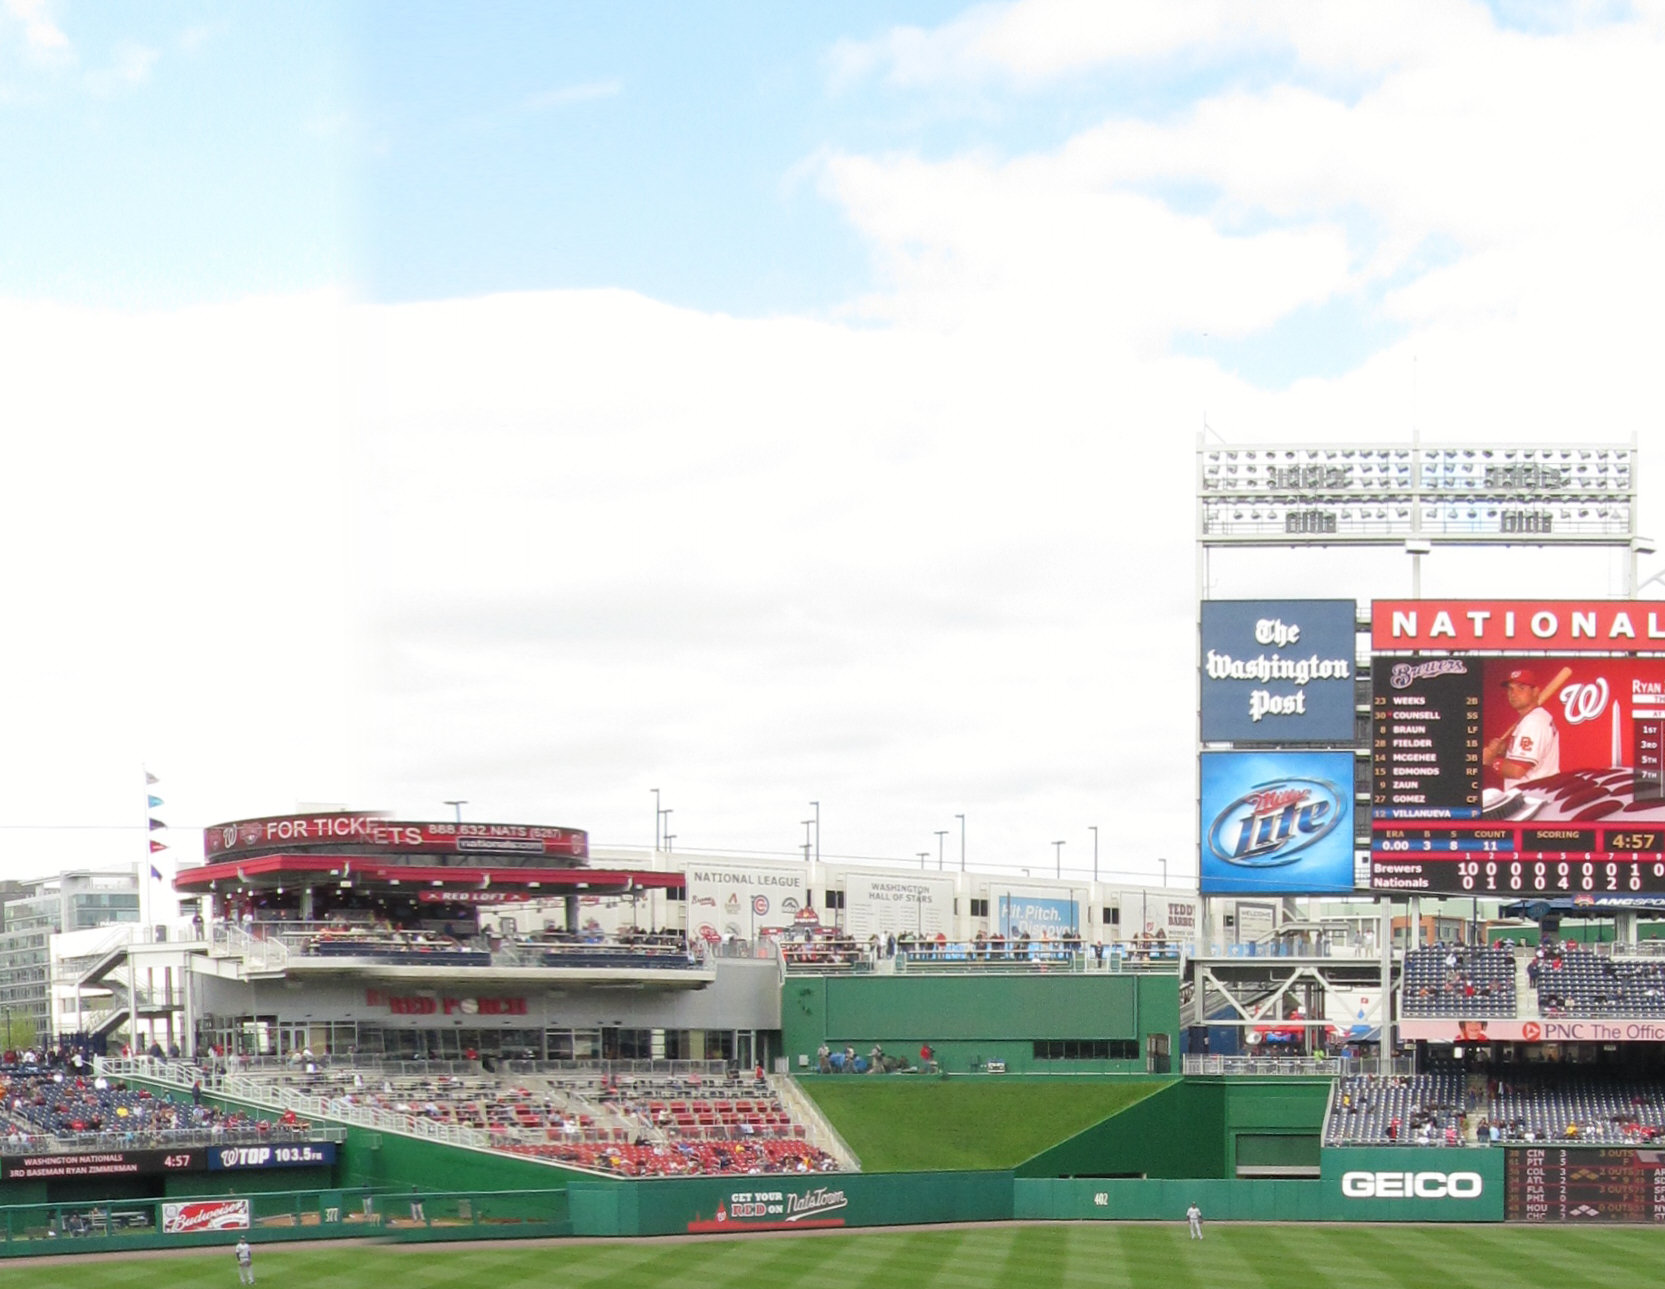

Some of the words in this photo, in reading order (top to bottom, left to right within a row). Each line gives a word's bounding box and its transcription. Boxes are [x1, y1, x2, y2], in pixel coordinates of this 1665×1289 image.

[1255, 619, 1300, 647] The
[1206, 650, 1350, 684] Washington
[1391, 660, 1468, 689] Brewers
[1632, 680, 1661, 693] RYAN
[1249, 689, 1306, 721] Post
[1393, 697, 1425, 705] WEEKS
[1393, 712, 1440, 720] COUNSELL
[1393, 726, 1425, 734] BRAUN
[1393, 739, 1432, 748] FIELDER
[1393, 754, 1436, 762] MCGEHEE
[1393, 768, 1439, 776] EDMONDS
[1393, 781, 1418, 789] ZAUN
[1393, 795, 1425, 803] GOMEZ
[1393, 810, 1451, 818] VILLANUEVA
[267, 820, 308, 840] FOR
[1233, 800, 1330, 858] Lite
[1537, 831, 1579, 839] SCORING
[1382, 841, 1409, 851] 0.00
[1612, 834, 1655, 849] 4:57
[1374, 863, 1422, 873] Brewers
[694, 872, 753, 885] NATIONAL
[758, 875, 800, 888] LEAGUE
[1374, 878, 1428, 888] Nationals
[872, 883, 930, 894] WASHINGTON
[443, 892, 470, 901] RED
[473, 892, 507, 901] LOFT
[869, 892, 891, 901] HALL
[894, 893, 905, 901] OF
[906, 894, 933, 903] STARS
[1026, 906, 1061, 922] Pitch.
[1545, 1024, 1584, 1039] PNC
[1590, 1024, 1621, 1039] The
[24, 1156, 76, 1166] WASHINGTON
[79, 1154, 123, 1165] NATIONALS
[164, 1155, 190, 1168] 4:57
[9, 1168, 24, 1177] 3RD
[26, 1167, 64, 1177] BASEMAN
[66, 1166, 87, 1176] RYAN
[89, 1164, 137, 1175] ZIMMERMAN
[1342, 1171, 1482, 1198] GEICO
[731, 1193, 752, 1202] GET
[755, 1192, 783, 1201] YOUR
[786, 1187, 847, 1214] NatsTown
[1094, 1193, 1108, 1206] 402
[173, 1201, 245, 1231] Budweiser
[731, 1203, 766, 1217] RED
[768, 1205, 783, 1213] ON
